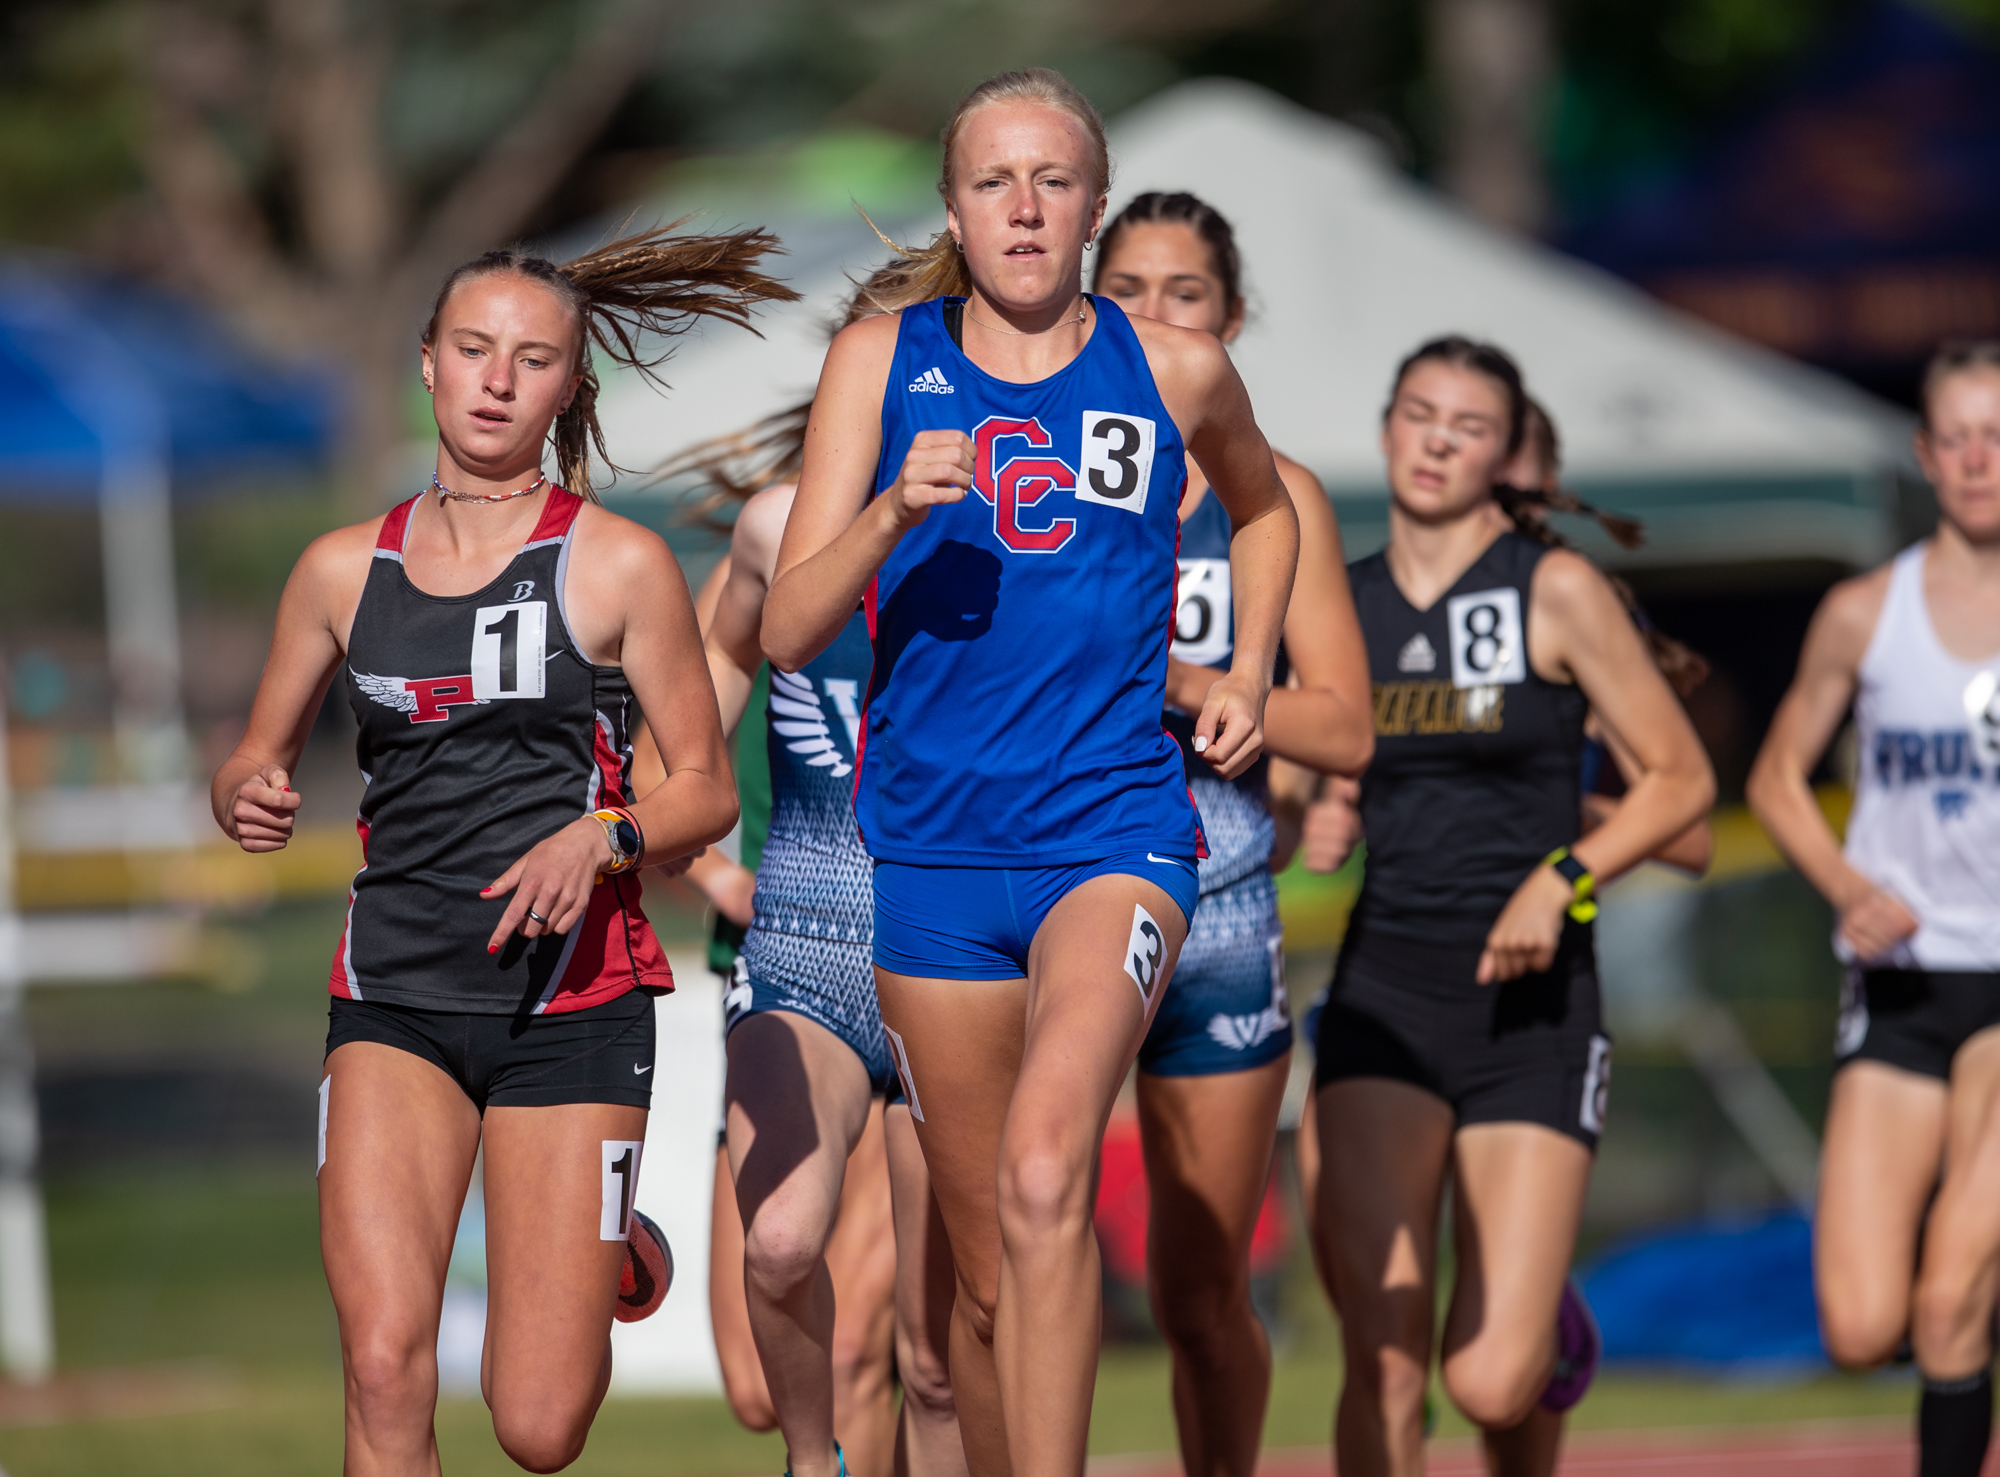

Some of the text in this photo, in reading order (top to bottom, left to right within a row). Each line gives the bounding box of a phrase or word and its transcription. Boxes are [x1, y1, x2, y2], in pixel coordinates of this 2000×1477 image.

[909, 381, 955, 394] adidas
[1088, 418, 1140, 499] 3
[485, 609, 519, 692] 1
[1465, 604, 1503, 672] 8
[405, 675, 477, 724] P
[1134, 920, 1162, 999] 3
[611, 1148, 633, 1234] 1
